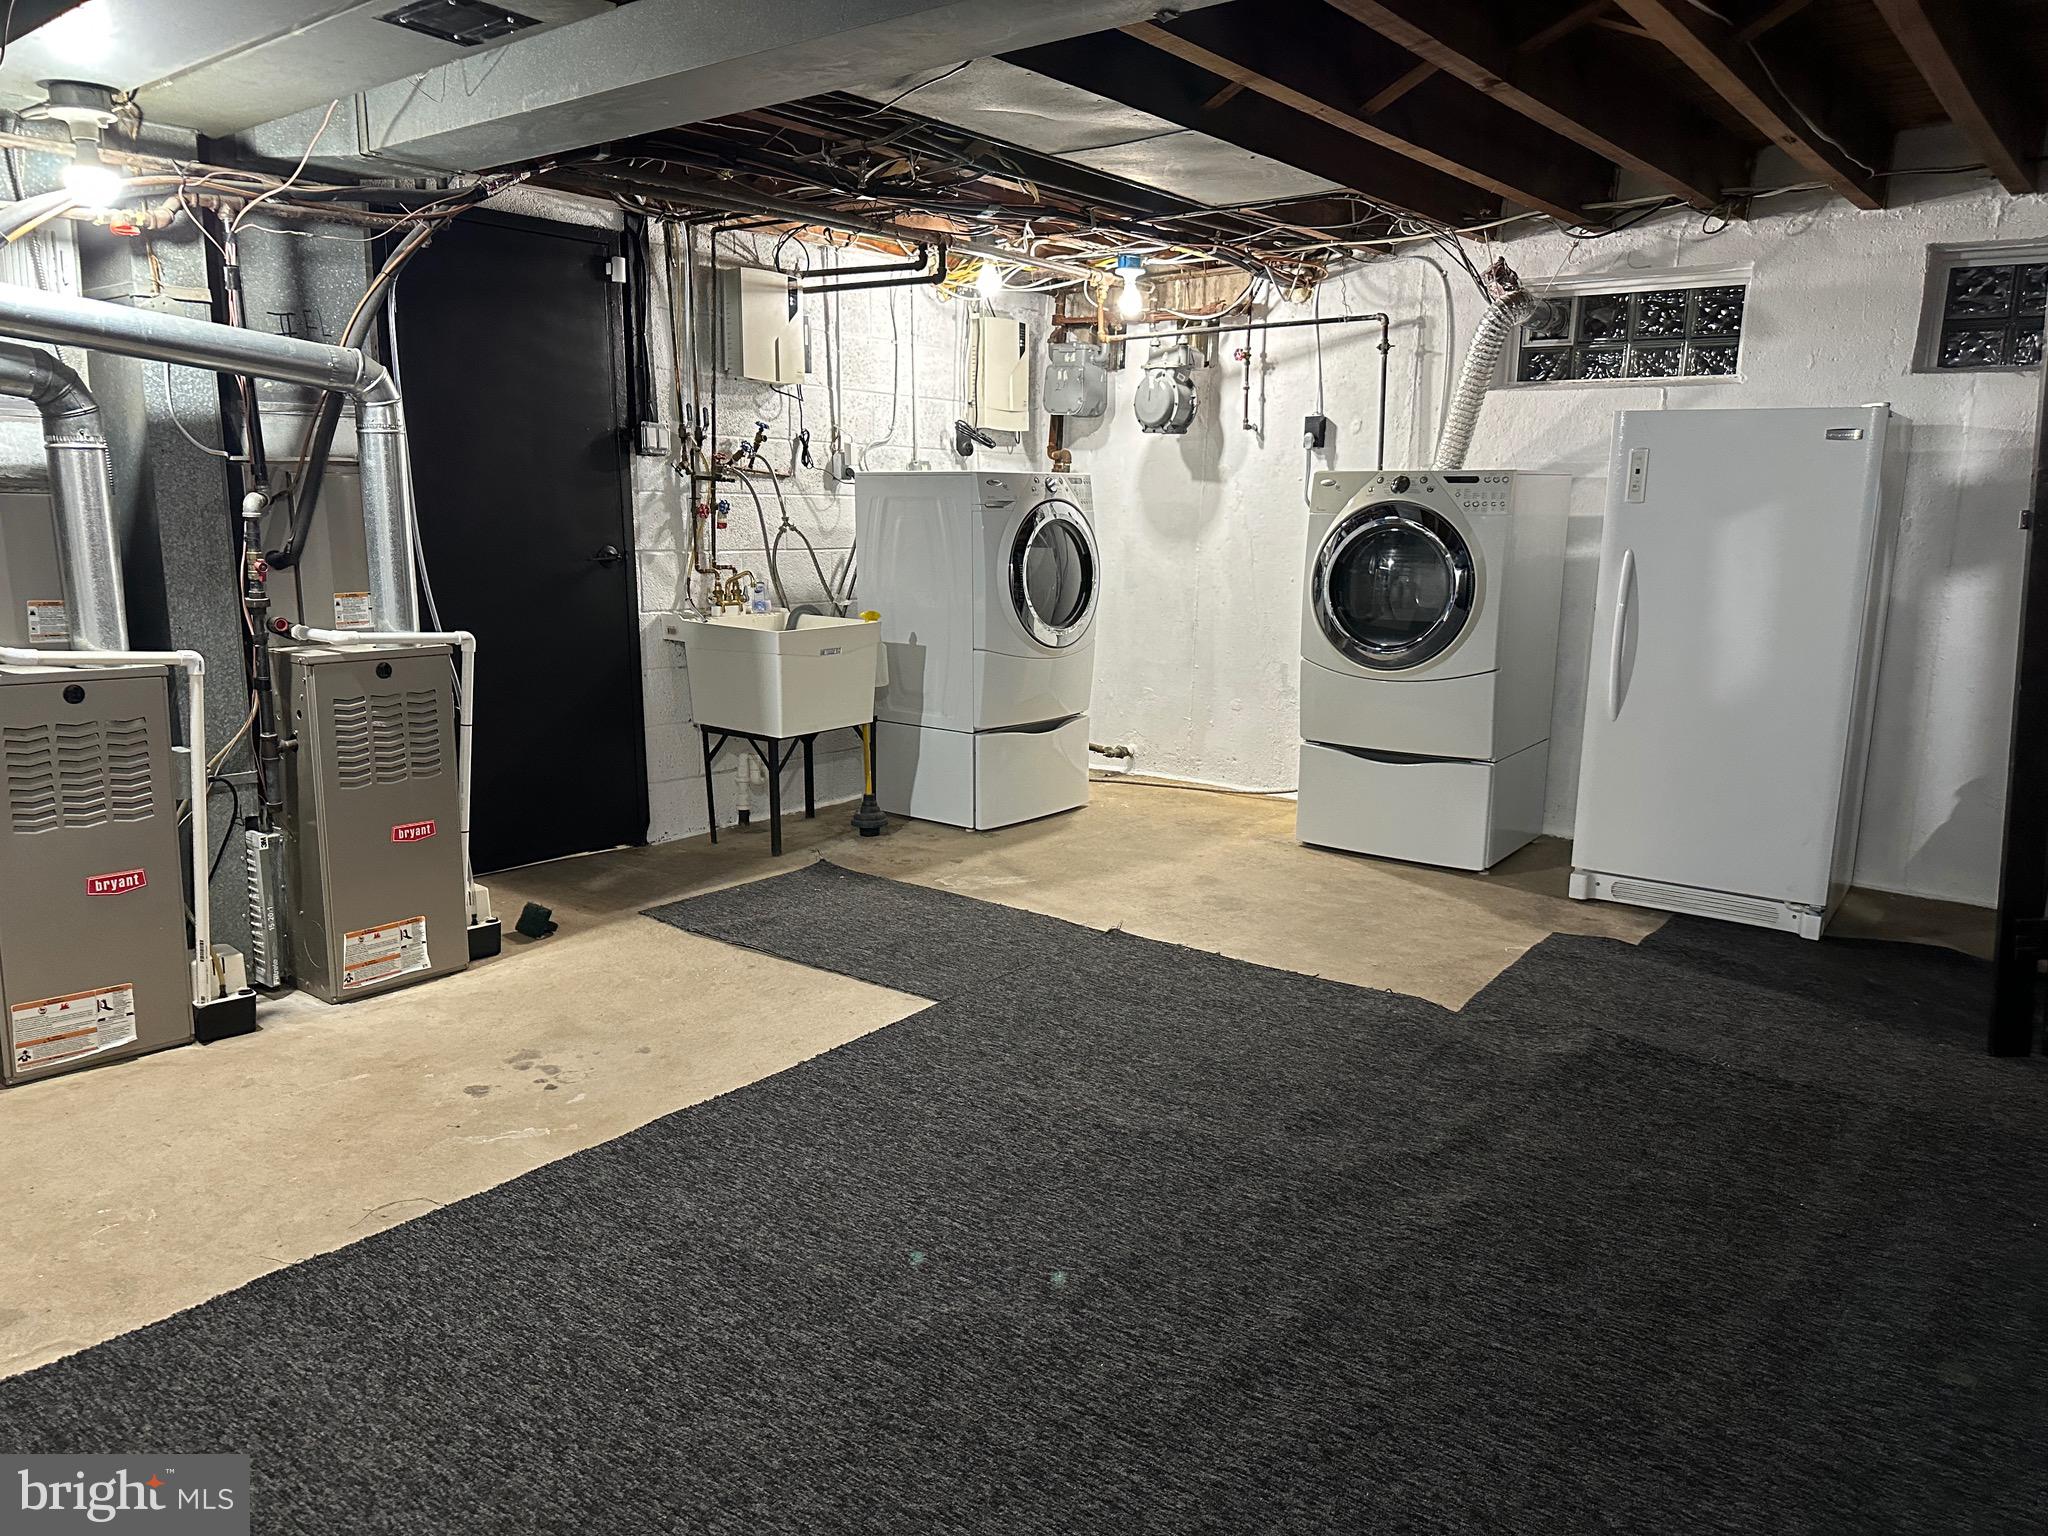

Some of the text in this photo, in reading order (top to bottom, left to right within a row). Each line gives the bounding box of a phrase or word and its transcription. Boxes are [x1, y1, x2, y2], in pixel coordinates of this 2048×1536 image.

[398, 824, 431, 839] bryant
[260, 836, 268, 848] 3M
[94, 873, 140, 892] bryant
